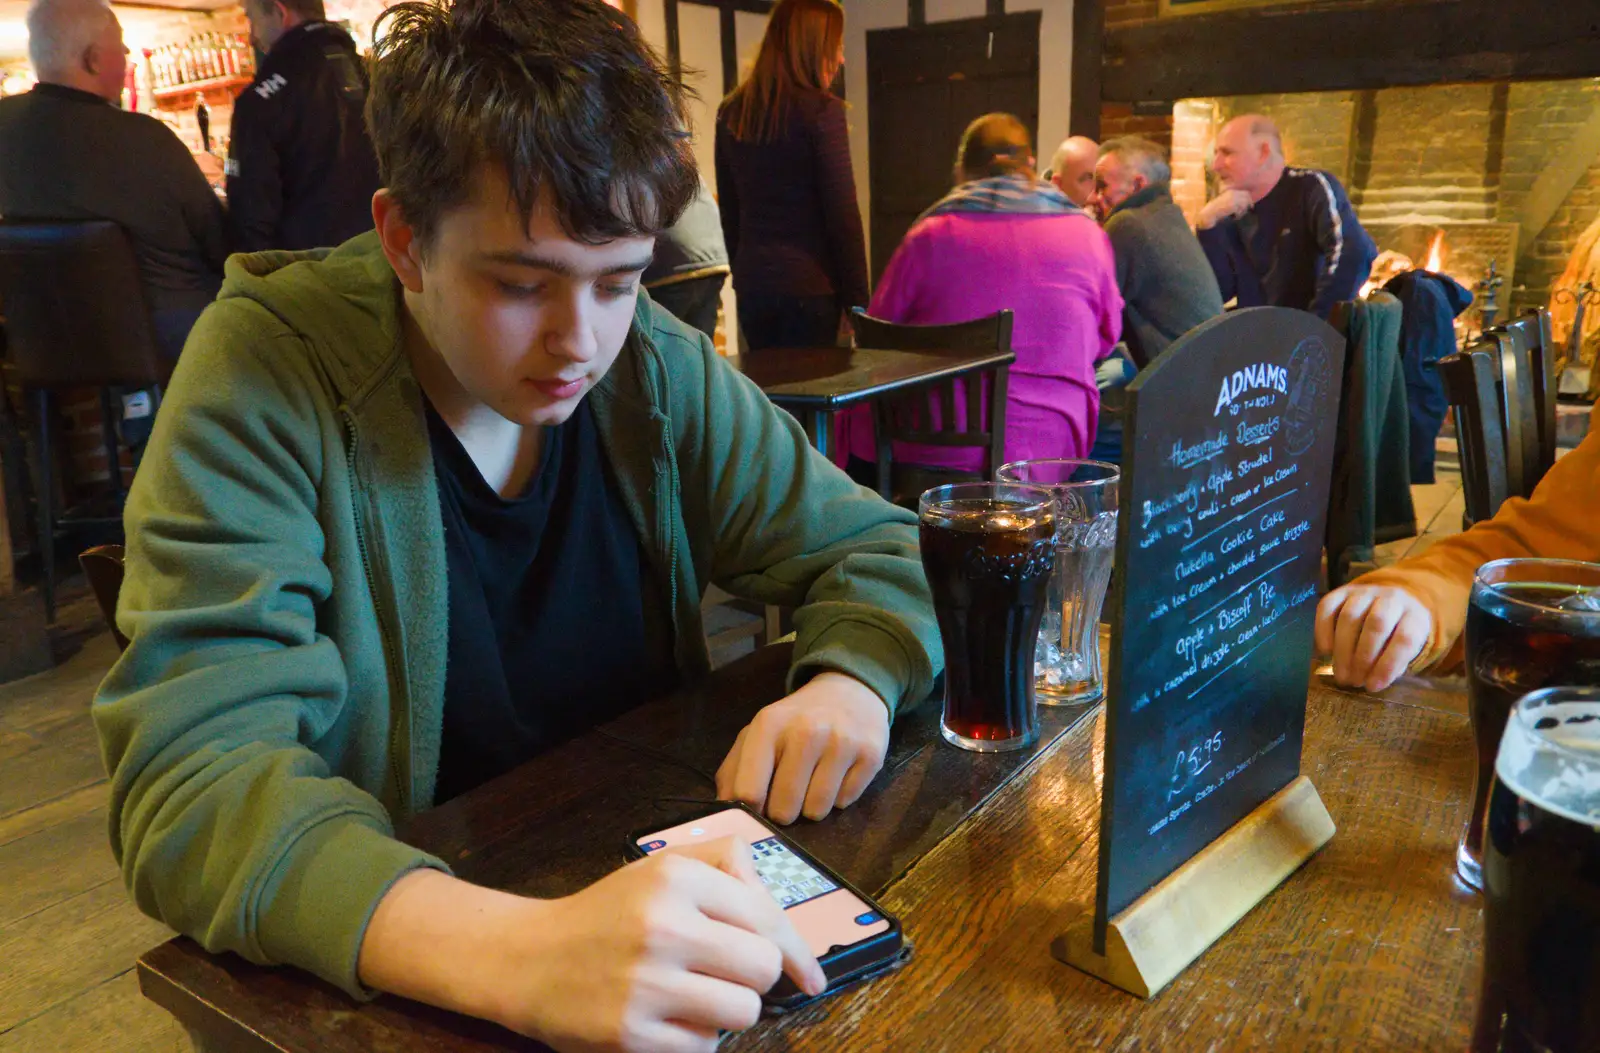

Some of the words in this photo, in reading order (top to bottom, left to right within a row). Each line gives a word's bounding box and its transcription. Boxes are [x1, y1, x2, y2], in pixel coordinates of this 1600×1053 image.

[1168, 430, 1229, 467] Homemade
[1236, 416, 1280, 444] Desserts
[1174, 551, 1215, 580] Nutella
[1220, 528, 1254, 554] Cookie
[1259, 510, 1286, 531] Cake
[1217, 592, 1253, 630] Biscoff
[1257, 581, 1276, 608] Pie
